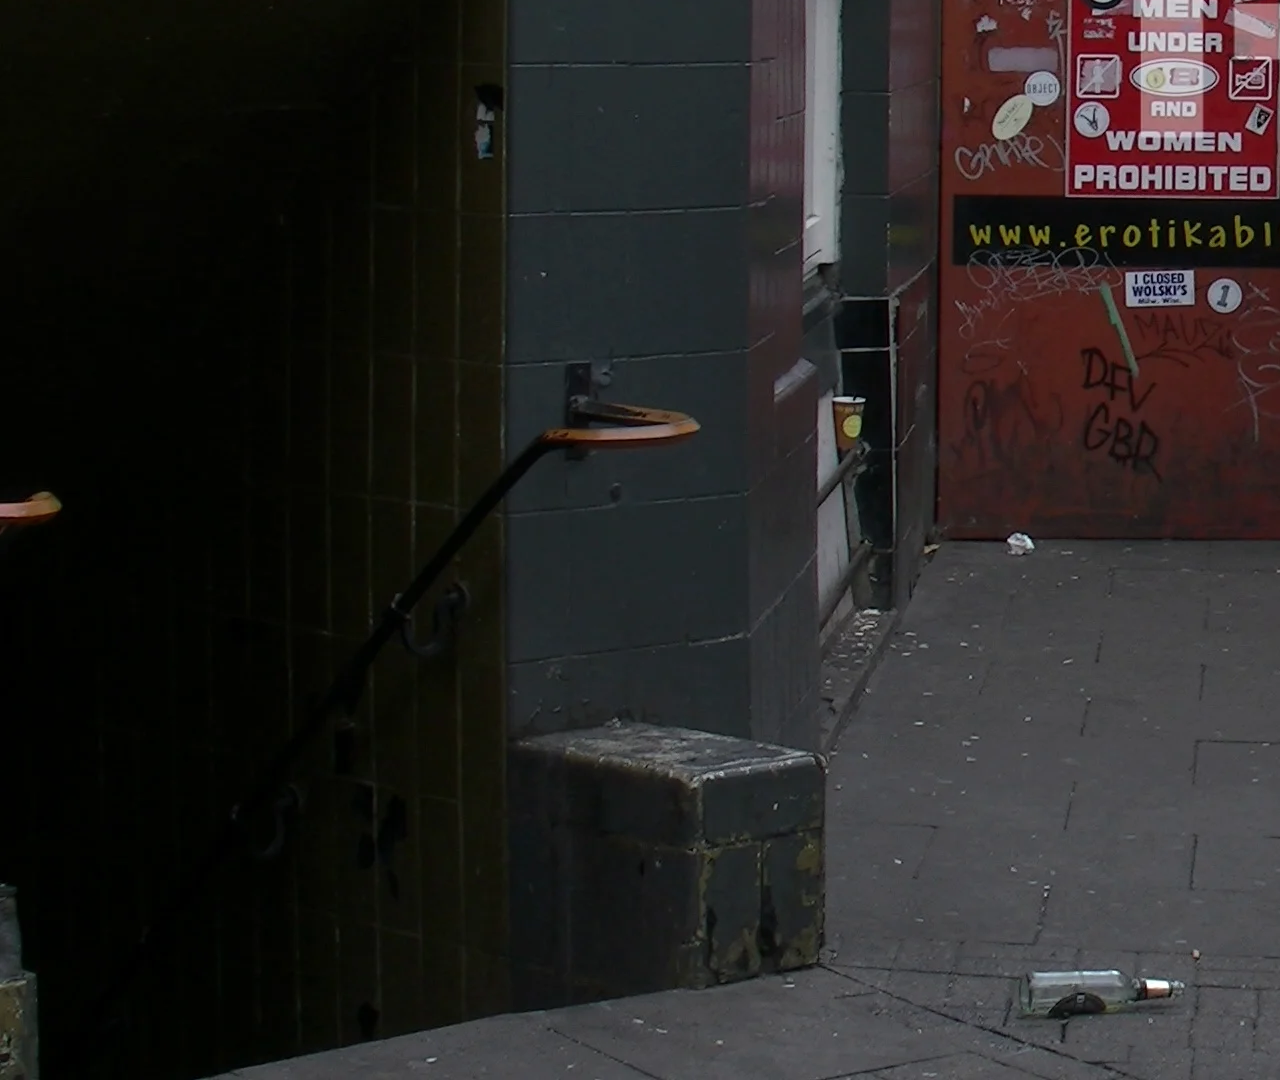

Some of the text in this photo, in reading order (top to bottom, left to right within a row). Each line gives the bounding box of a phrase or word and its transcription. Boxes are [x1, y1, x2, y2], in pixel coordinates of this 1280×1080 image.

[1128, 31, 1223, 52] UNDER
[1027, 83, 1059, 95] OBJECT
[1151, 101, 1197, 118] AND
[1106, 131, 1242, 153] WOMEN
[1073, 165, 1272, 192] PROHIBITED
[1134, 272, 1185, 285] I CLOSED
[1132, 284, 1188, 298] WOLSKI'S
[1216, 284, 1230, 308] 1
